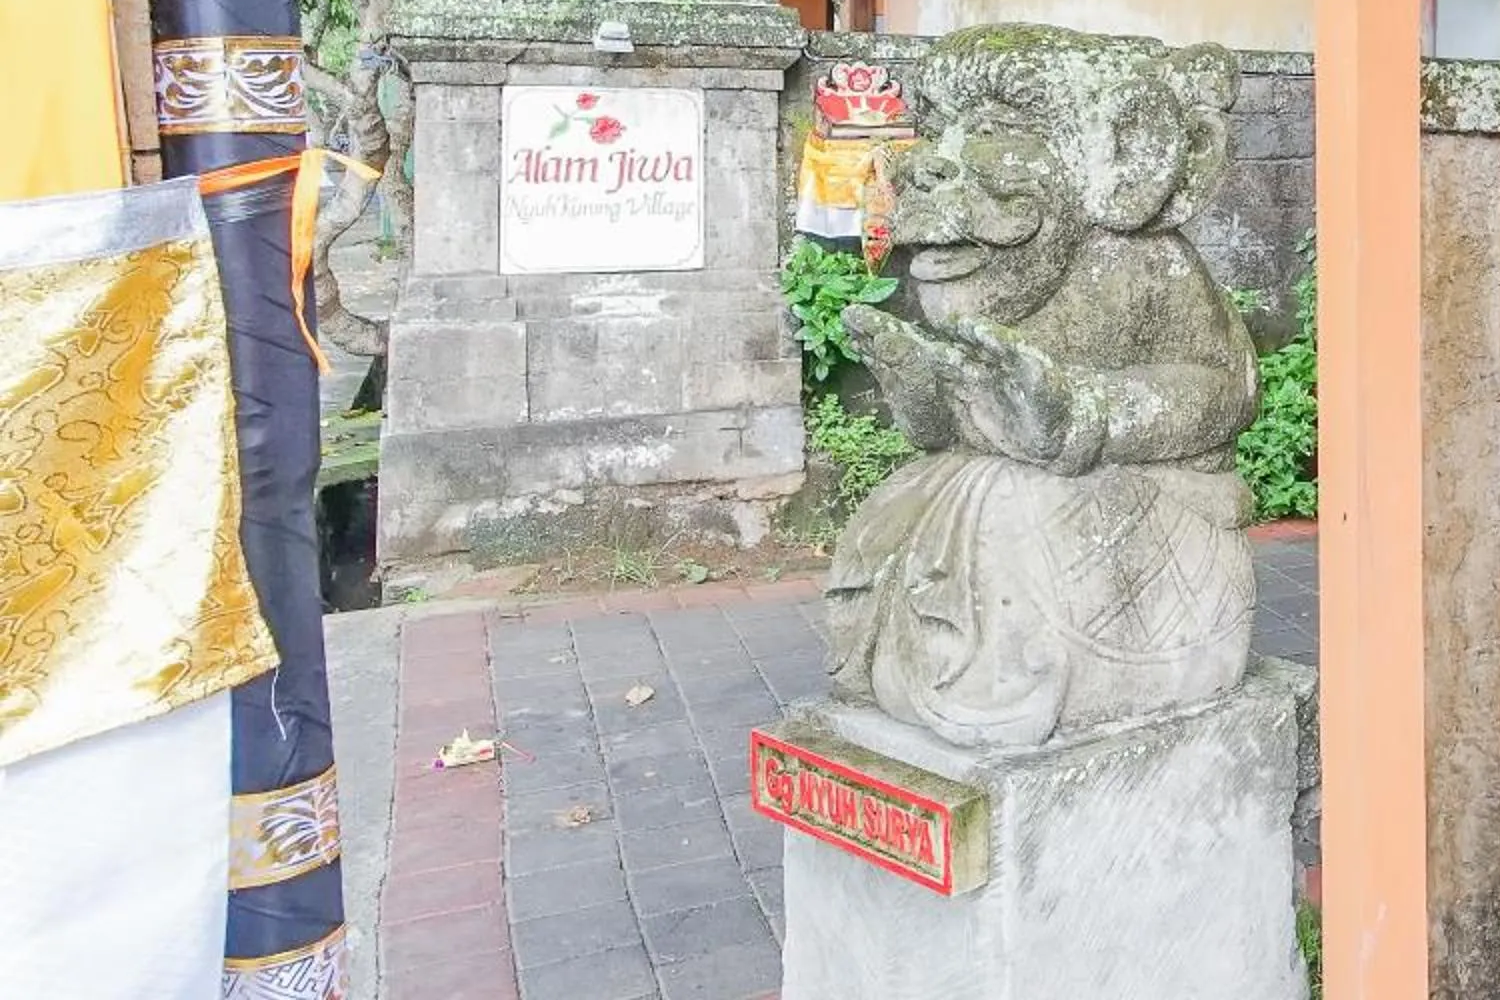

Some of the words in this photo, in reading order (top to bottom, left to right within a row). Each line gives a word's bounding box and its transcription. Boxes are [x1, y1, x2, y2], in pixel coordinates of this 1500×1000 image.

[508, 147, 599, 184] Alam
[605, 148, 694, 194] Jiwa
[626, 190, 695, 222] Village
[798, 770, 858, 829] NYUH
[863, 795, 936, 866] SURYA
